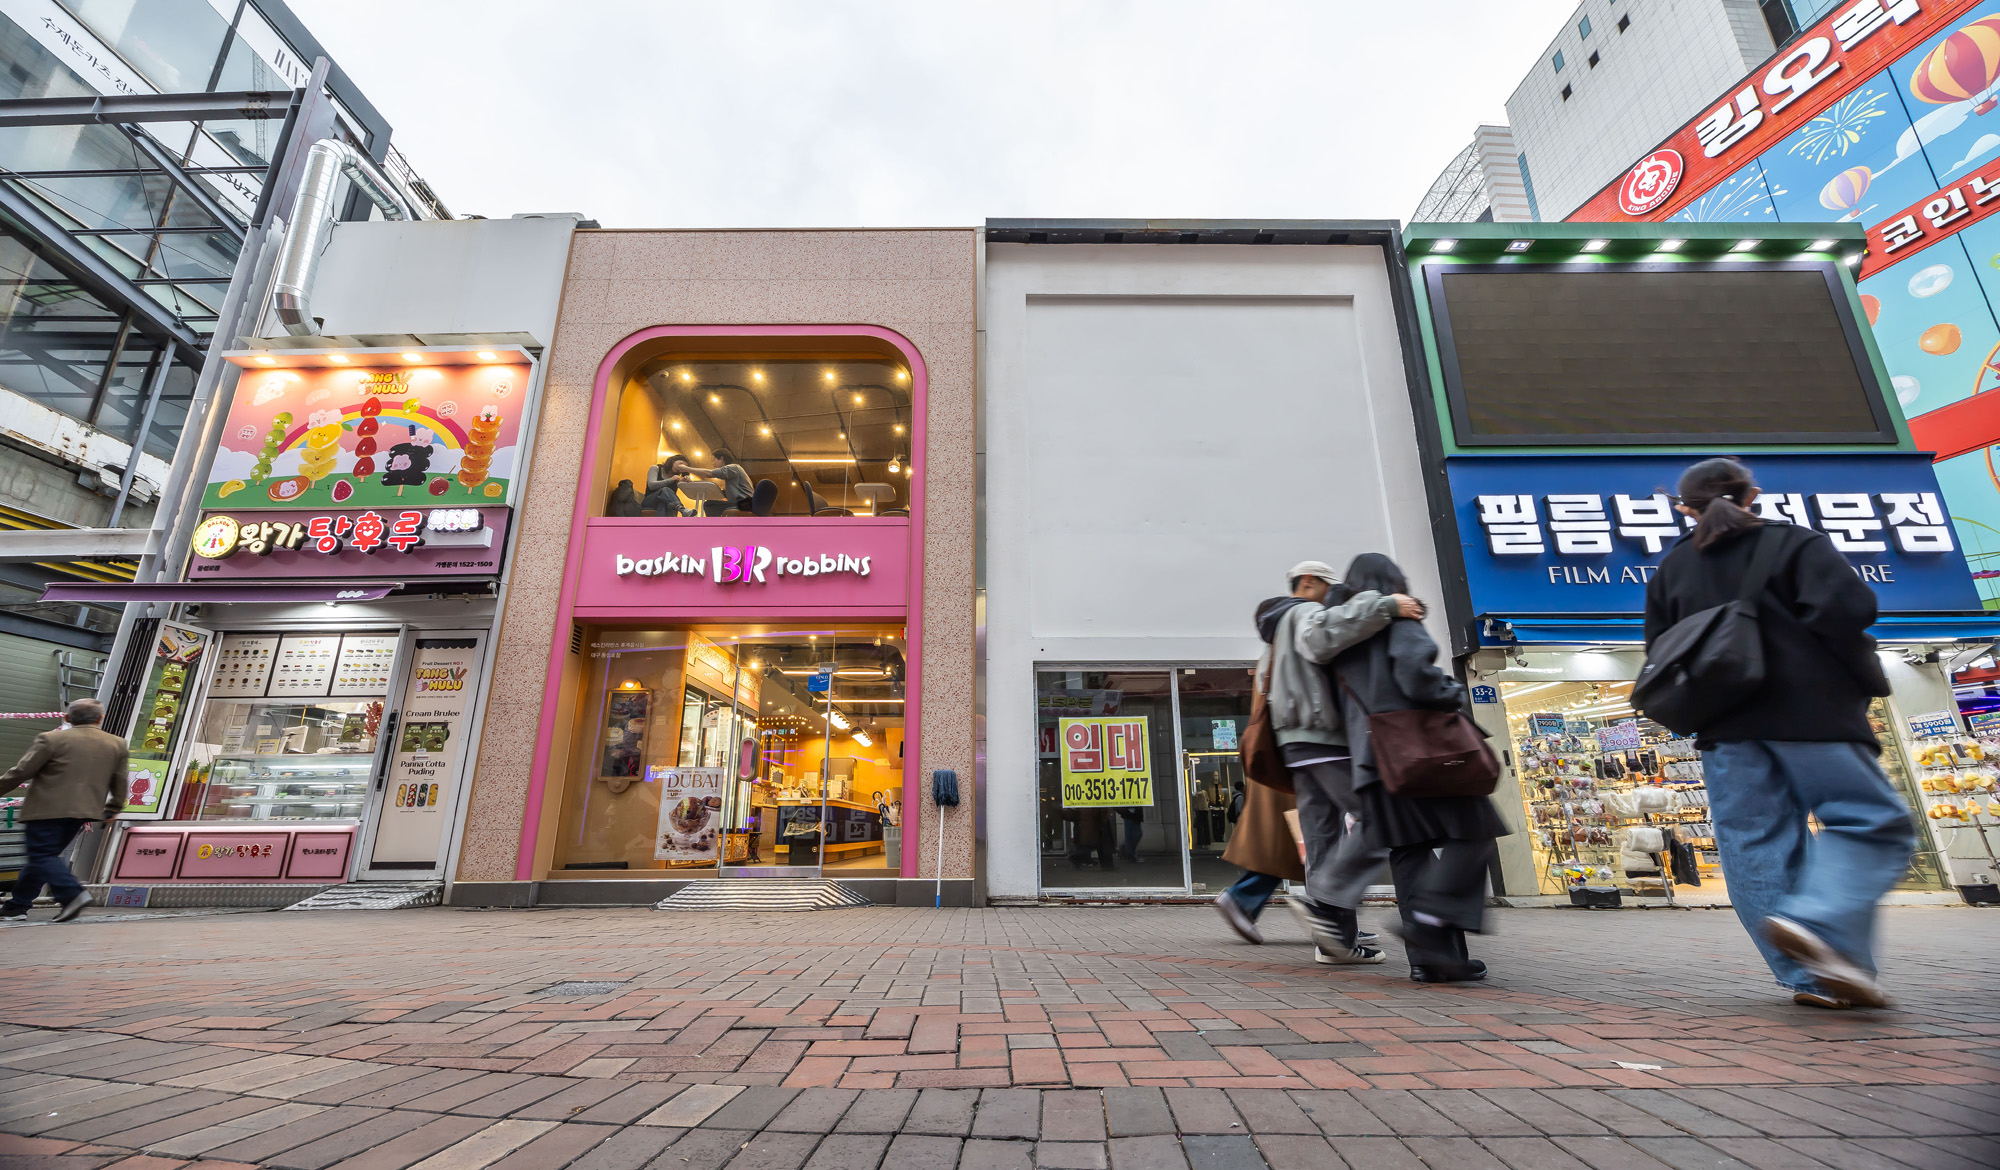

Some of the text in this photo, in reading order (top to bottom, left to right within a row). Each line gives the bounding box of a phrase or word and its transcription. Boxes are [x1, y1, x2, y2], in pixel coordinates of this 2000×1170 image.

[1649, 171, 1679, 207] ARCADE
[372, 383, 409, 395] HULU
[238, 511, 423, 553] 왕가 탕후루
[616, 546, 871, 583] baskin BR robbins
[1548, 566, 1611, 584] FILM
[415, 667, 449, 680] TANG
[428, 680, 463, 691] HULU
[1474, 687, 1493, 696] 33-2
[433, 709, 460, 717] Brulee
[1064, 722, 1144, 772] 임대
[425, 760, 446, 768] Cotta
[667, 773, 719, 789] DUBAI
[1064, 777, 1149, 801] 010-3513-1717
[214, 843, 273, 858] 왕가 탕후루
[115, 894, 141, 905] 점검구
